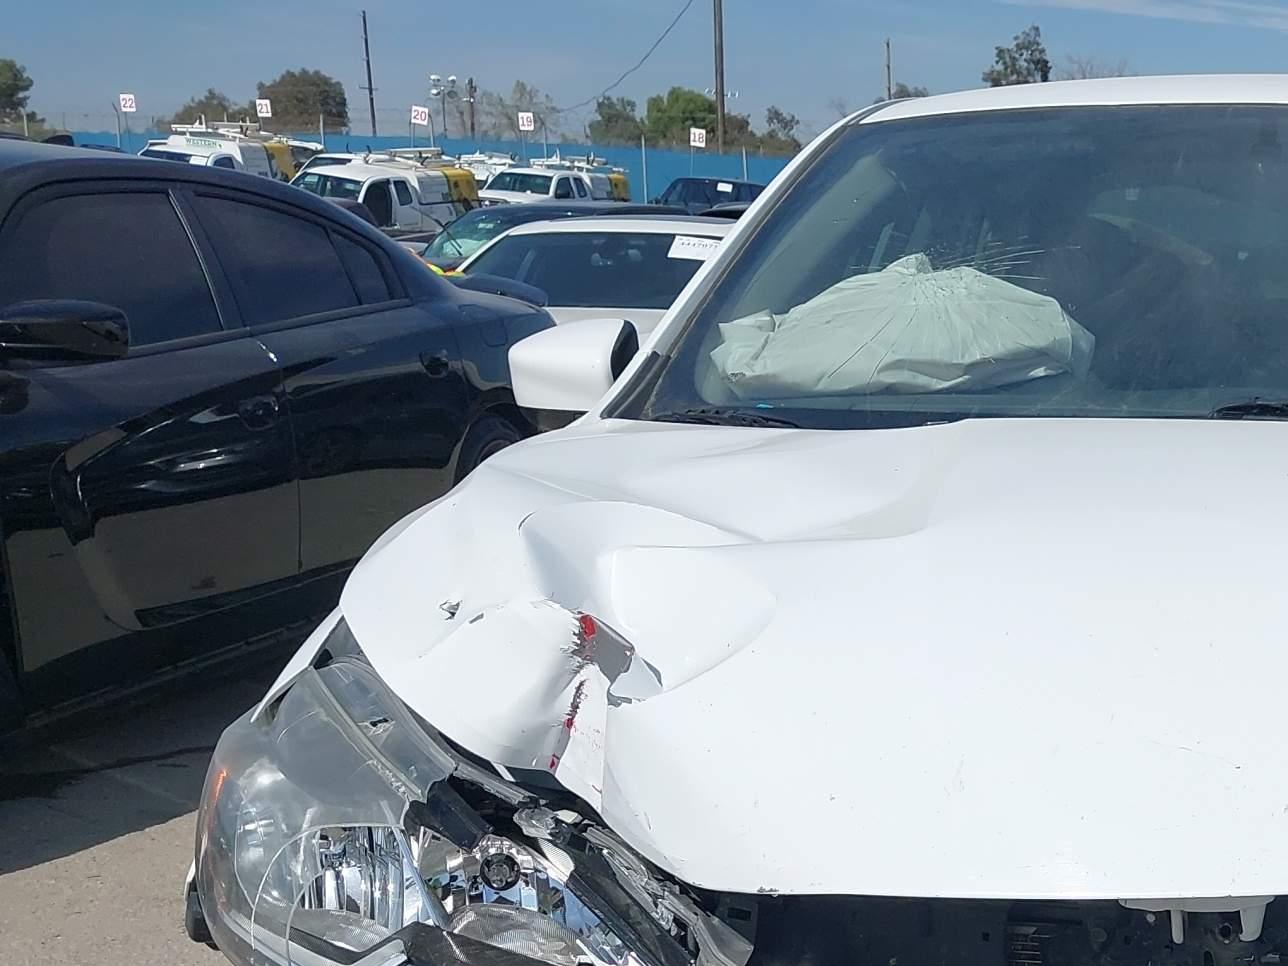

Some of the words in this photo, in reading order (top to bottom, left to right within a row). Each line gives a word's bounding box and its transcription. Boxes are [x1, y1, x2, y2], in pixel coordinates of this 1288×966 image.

[122, 97, 135, 109] 22
[257, 102, 270, 114] 21
[412, 109, 427, 121] 20
[520, 115, 533, 127] 19
[691, 131, 705, 144] 18
